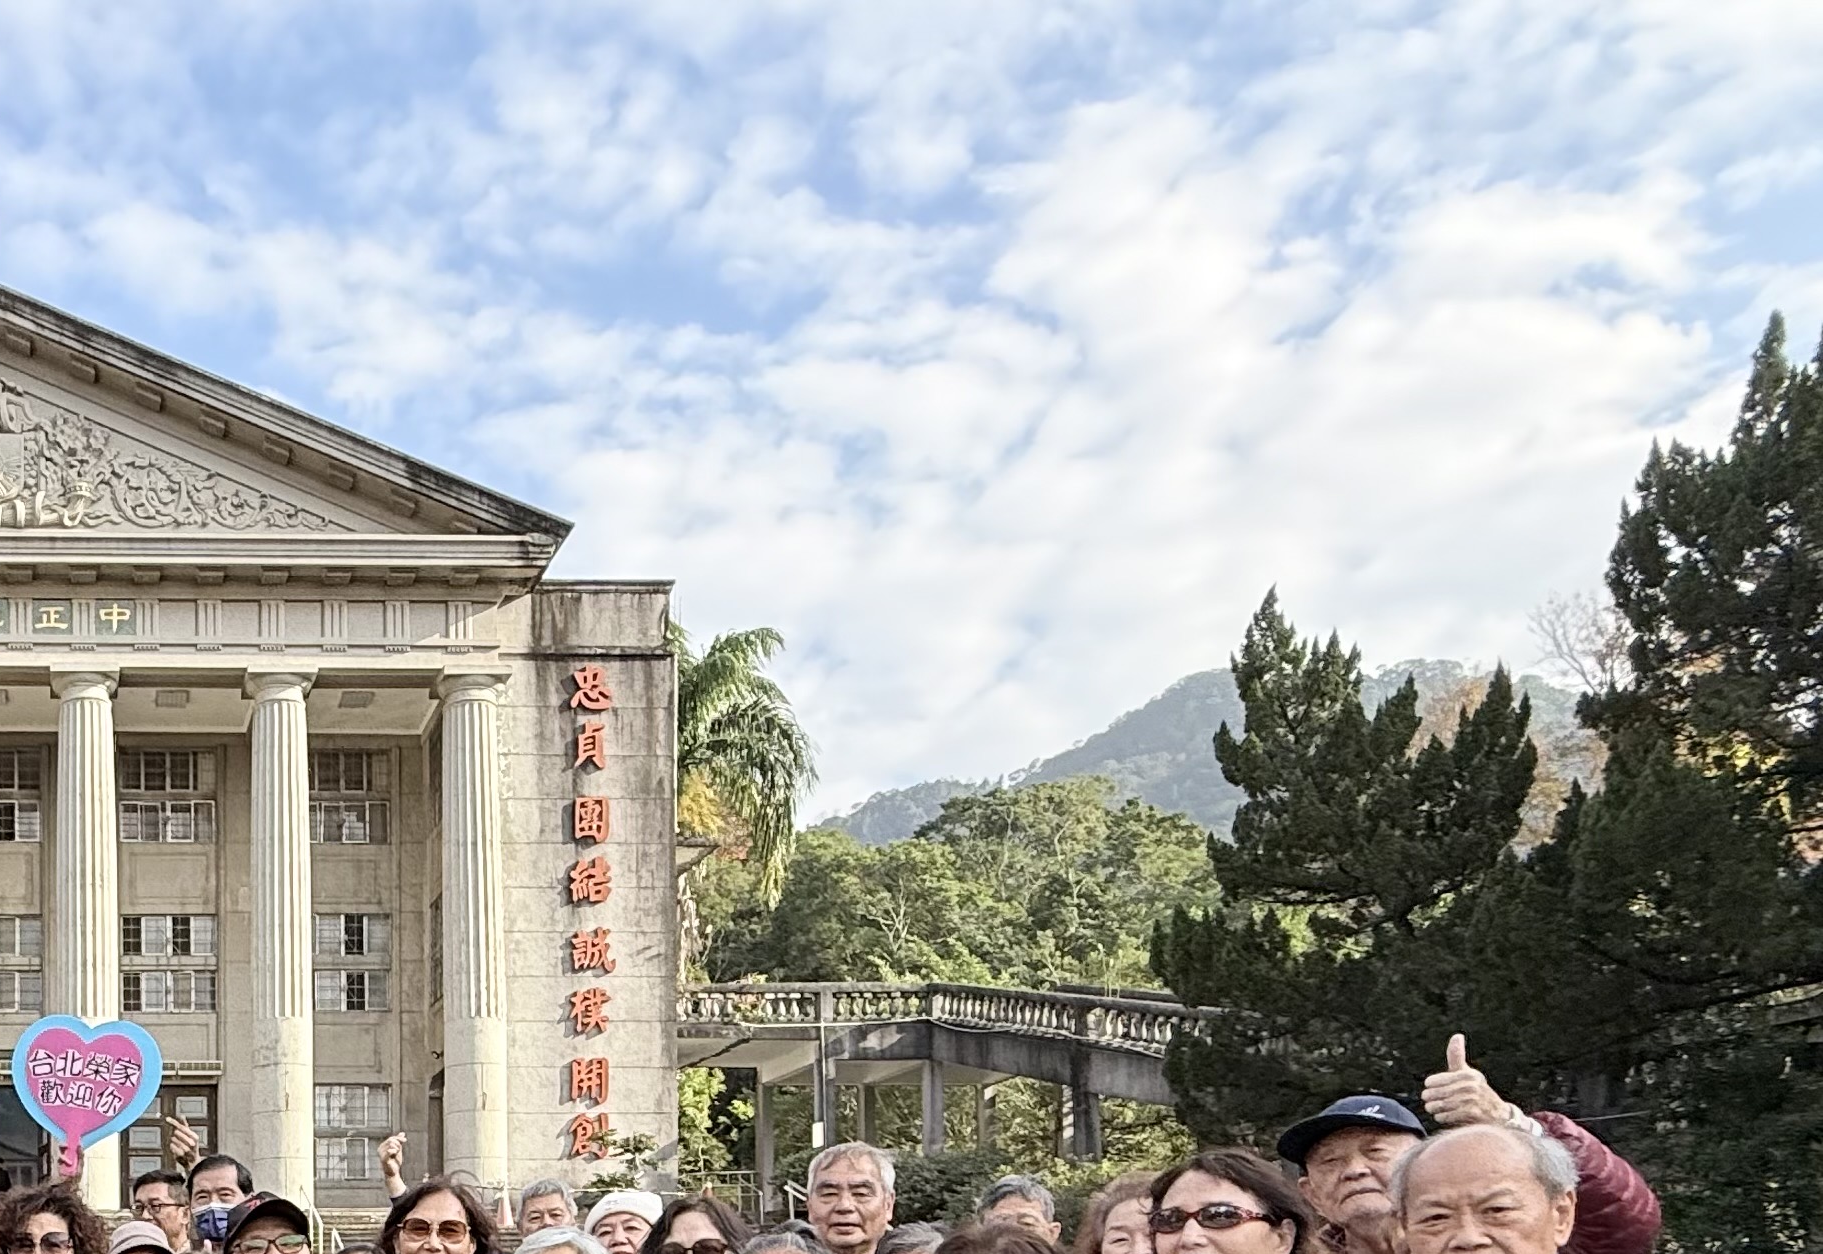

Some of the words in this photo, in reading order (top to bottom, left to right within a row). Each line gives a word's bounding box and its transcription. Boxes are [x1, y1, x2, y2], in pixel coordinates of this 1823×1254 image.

[29, 1050, 142, 1087] 台北榮家
[39, 1079, 122, 1115] 歡迎你
